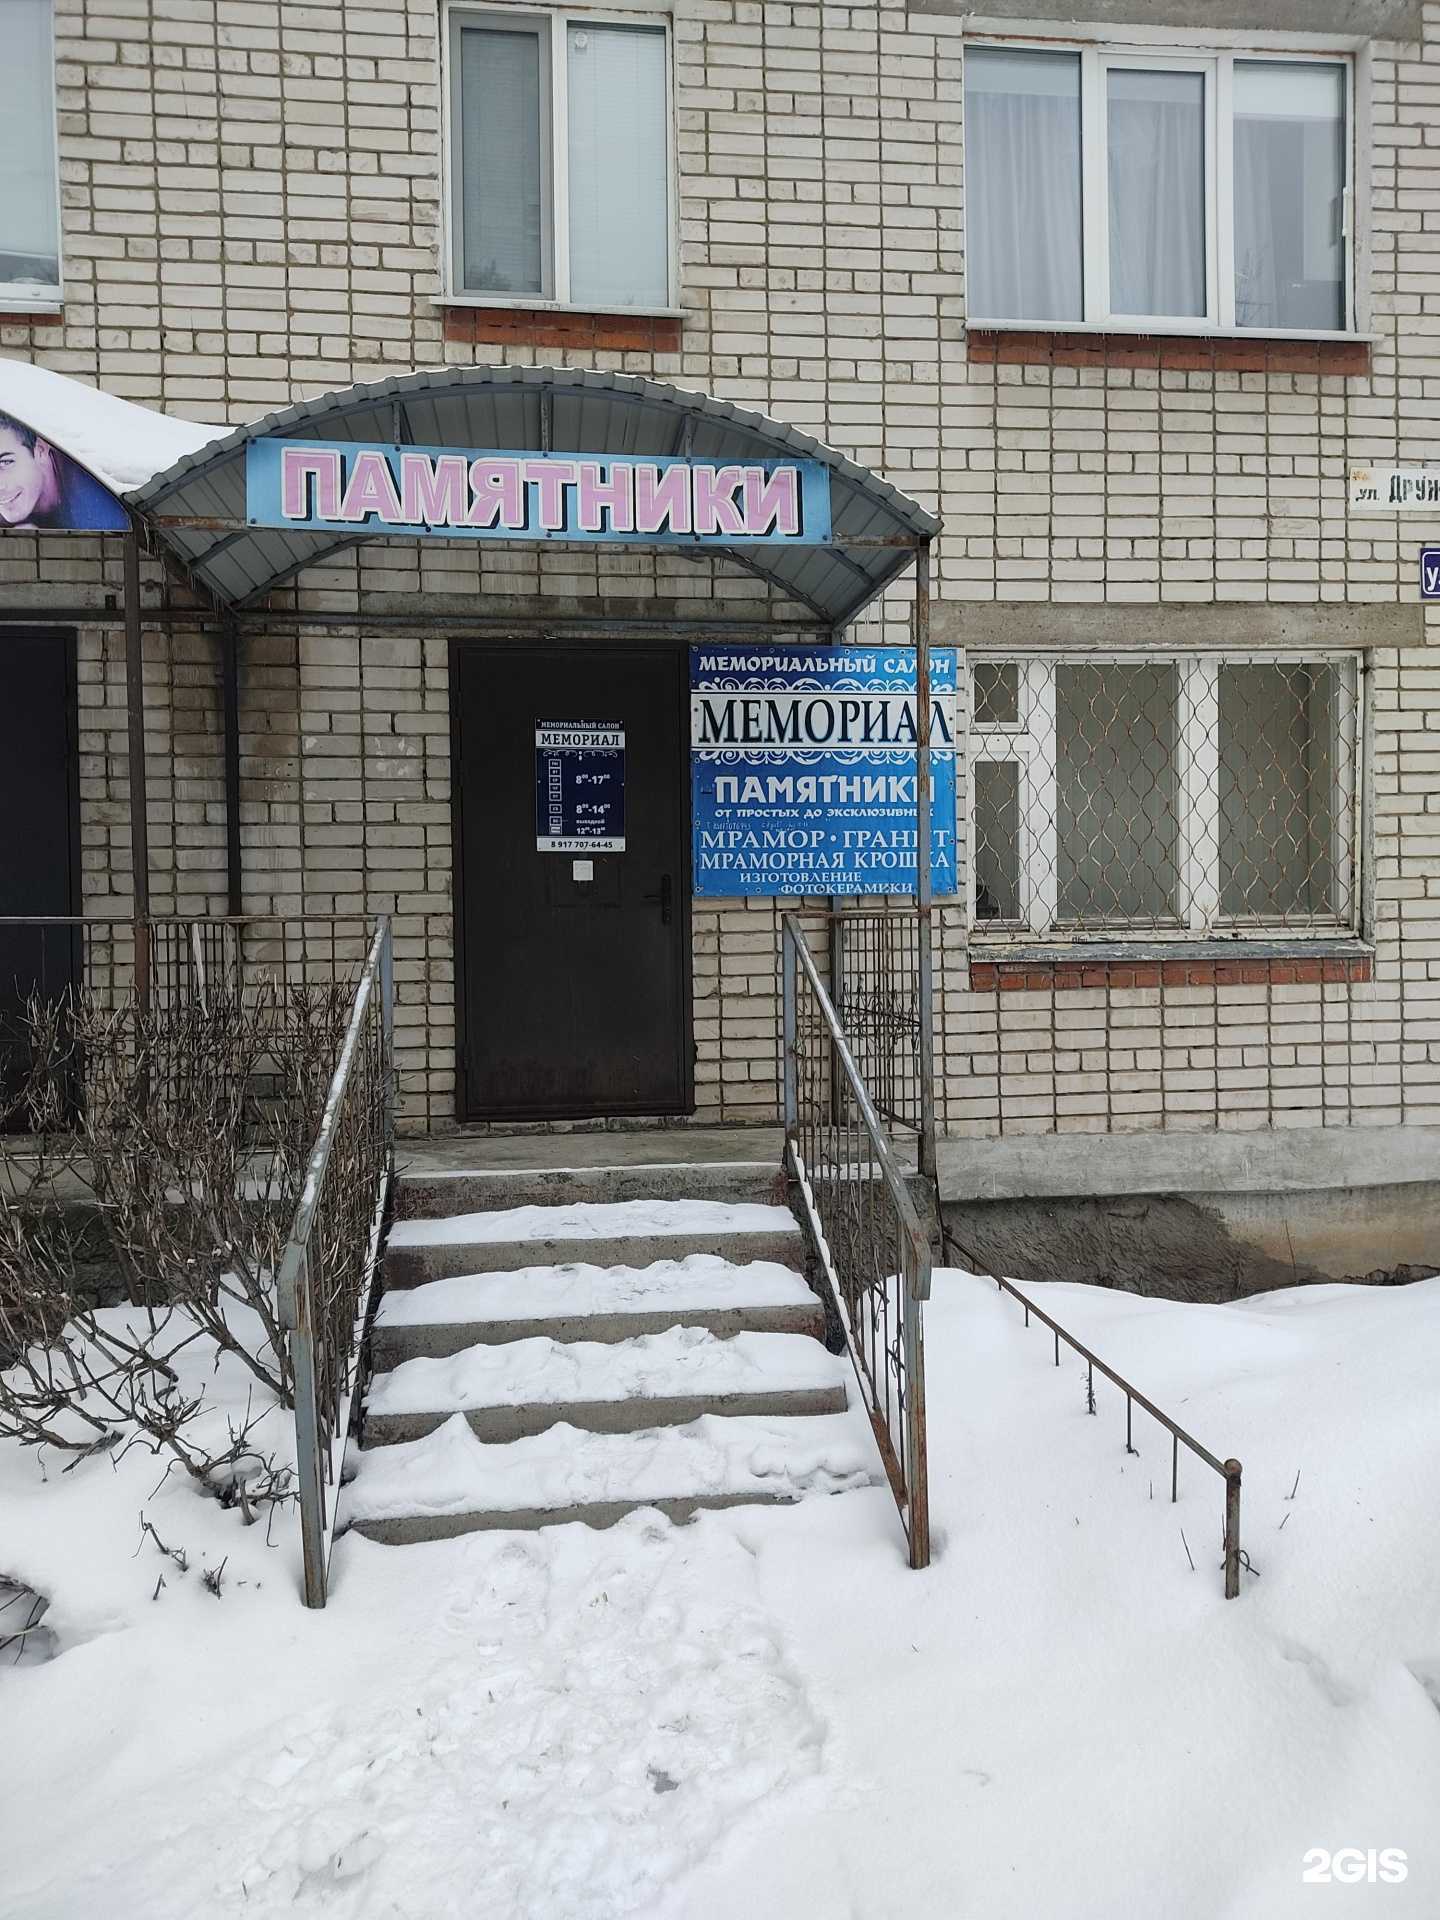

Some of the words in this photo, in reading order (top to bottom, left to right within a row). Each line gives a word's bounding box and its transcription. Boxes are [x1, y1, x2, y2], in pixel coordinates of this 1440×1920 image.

[281, 447, 801, 536] ПАМЯТНИКИ
[1426, 566, 1440, 591] у
[699, 655, 876, 674] МЕМОРИАЛЬНЫЙ
[541, 721, 597, 729] МЕМОРИАЛЬНЫЙ
[598, 722, 620, 730] САЛОН
[698, 699, 953, 744] МЕМОРИАЛ
[541, 733, 620, 746] МЕМОРИАЛ
[575, 841, 613, 850] 707-64-45
[701, 830, 825, 849] МРАМОР
[701, 852, 845, 870] МРАМОРНАЯ
[740, 872, 862, 883] ИЗГОТОВЛЕНИЕ
[780, 882, 912, 894] ФОТОКЕРАМИКИ
